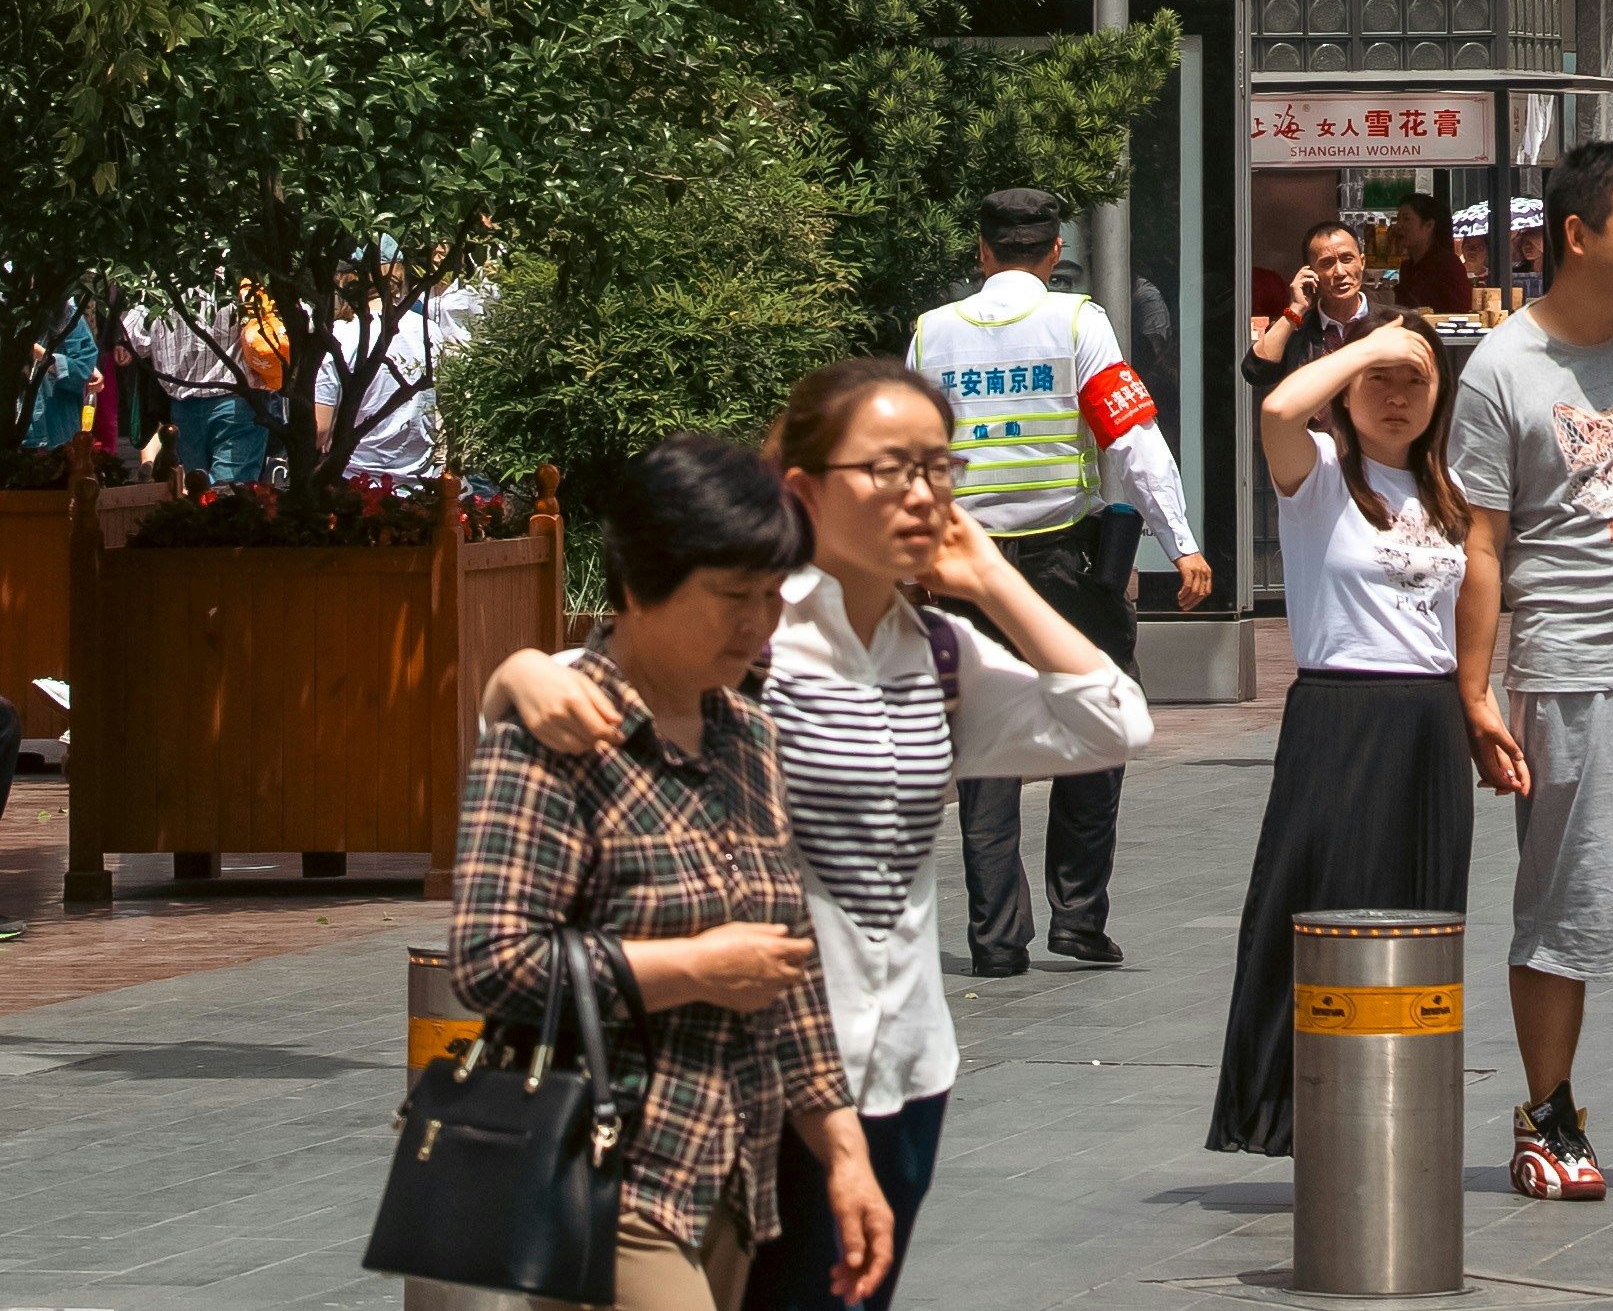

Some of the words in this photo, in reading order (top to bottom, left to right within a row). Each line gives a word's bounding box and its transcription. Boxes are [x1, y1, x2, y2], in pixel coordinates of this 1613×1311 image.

[1290, 145, 1360, 158] SHANGHAI
[1366, 144, 1422, 157] WOMAN
[940, 363, 1055, 397] 平安南京路
